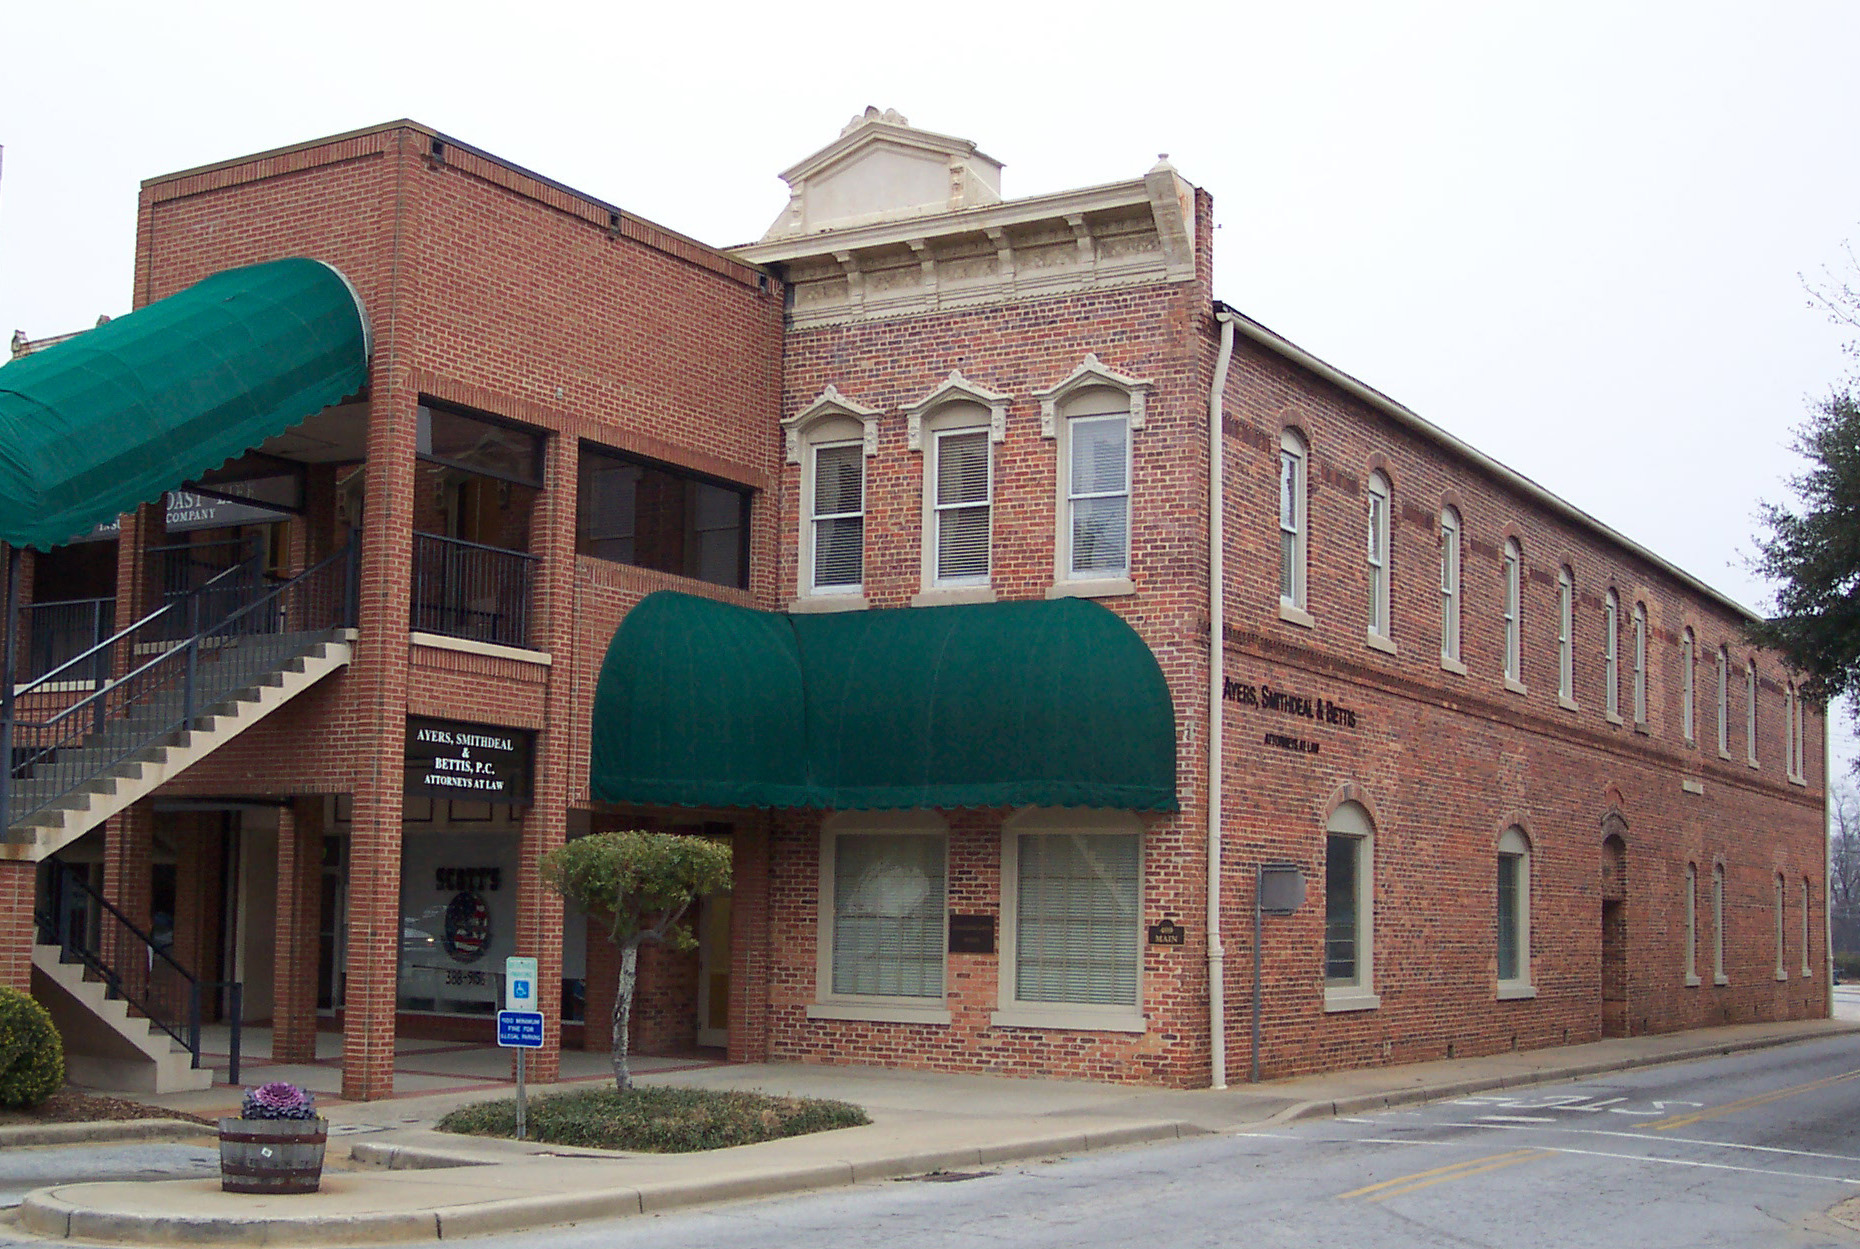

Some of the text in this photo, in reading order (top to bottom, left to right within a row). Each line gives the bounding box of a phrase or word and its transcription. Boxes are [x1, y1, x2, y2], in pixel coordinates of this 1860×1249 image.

[165, 507, 217, 524] COMPANY
[1222, 676, 1259, 710] AYERS,
[1316, 698, 1324, 720] &
[1326, 700, 1357, 728] BETTIS
[416, 729, 514, 751] AYERS, SMITHDEAL
[461, 747, 471, 758] &
[435, 757, 496, 775] BETTIS, P.C.
[424, 774, 505, 791] ATTORNEYS AT LAW
[1155, 934, 1179, 943] MAIN
